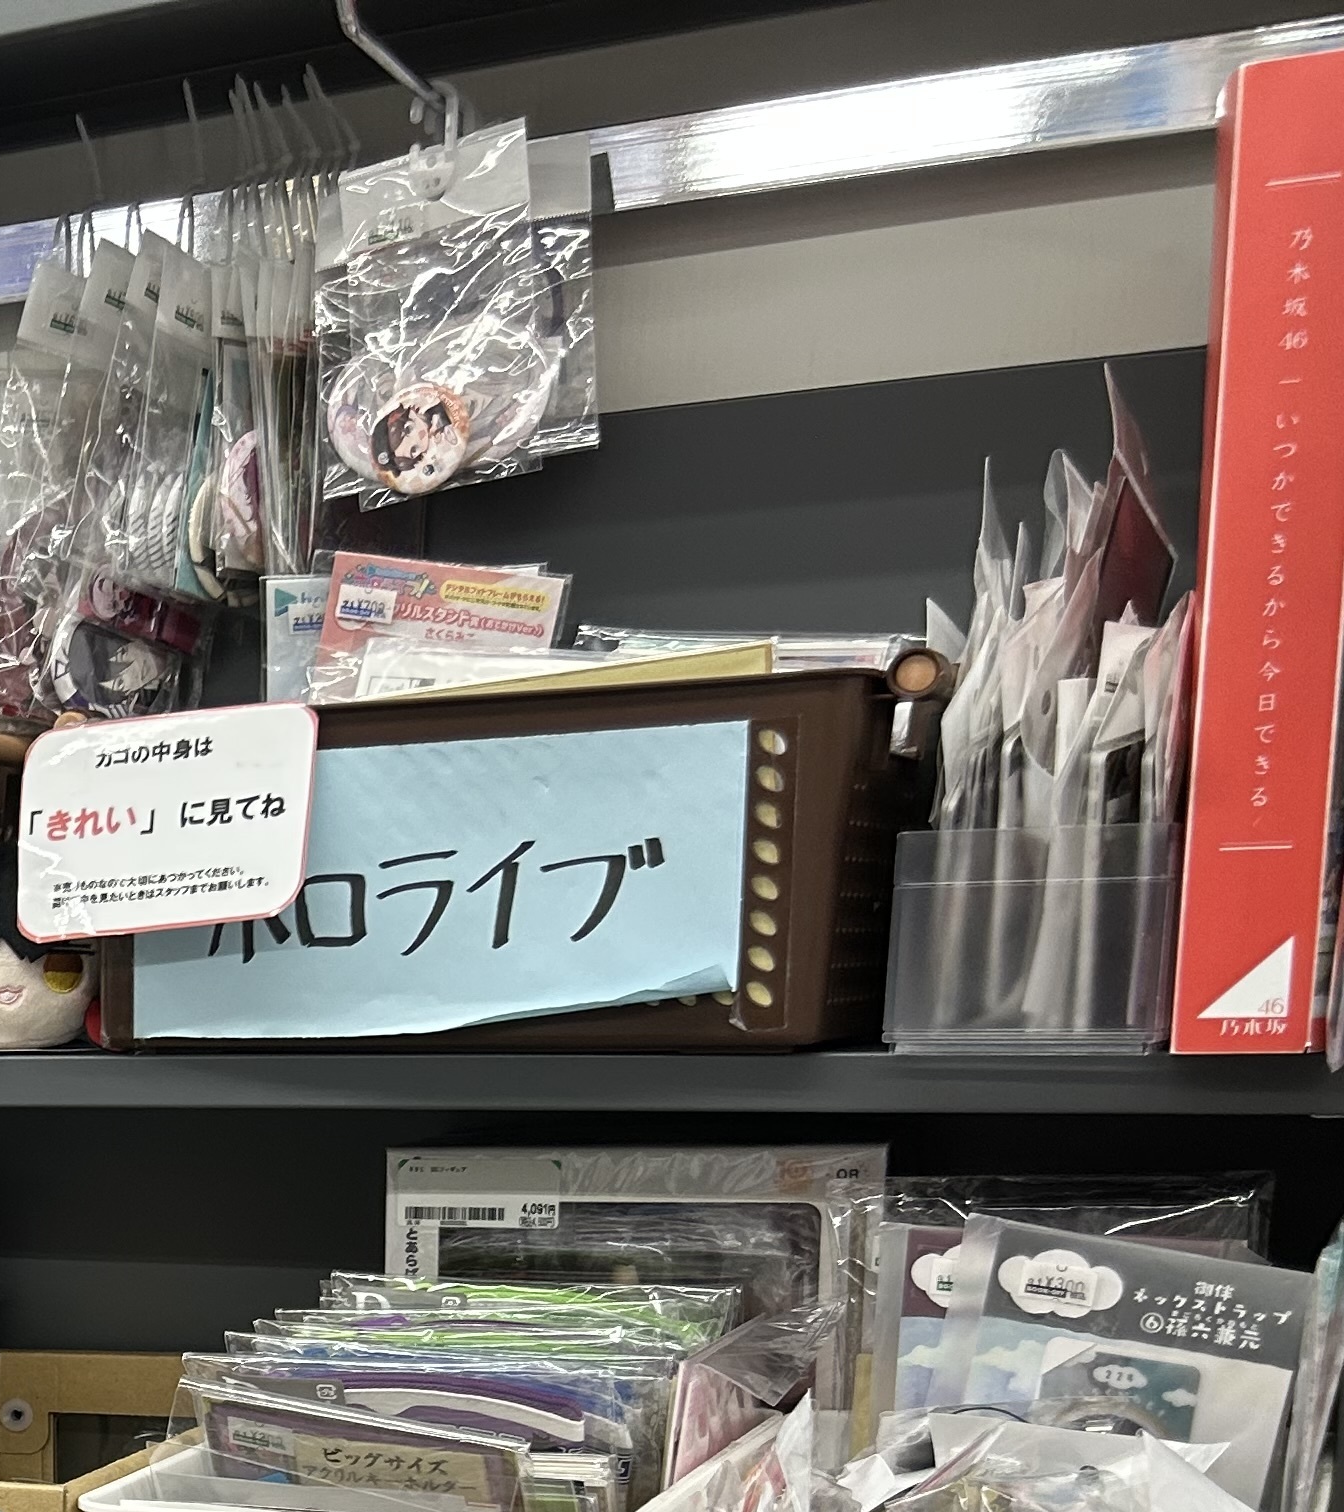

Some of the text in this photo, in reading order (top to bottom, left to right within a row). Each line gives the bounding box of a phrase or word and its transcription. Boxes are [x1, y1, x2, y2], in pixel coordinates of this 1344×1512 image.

[95, 737, 214, 770] カゴの中身は
[26, 793, 286, 841] 「きれい」に見てね
[1256, 995, 1286, 1015] 46
[1219, 1015, 1289, 1037] 乃木坂
[521, 1202, 556, 1217] 4,091円
[1132, 1287, 1292, 1326] ネックストラップ
[321, 1447, 449, 1477] ビッグサイズ
[301, 1464, 478, 1493] アクリルキーホルダー
